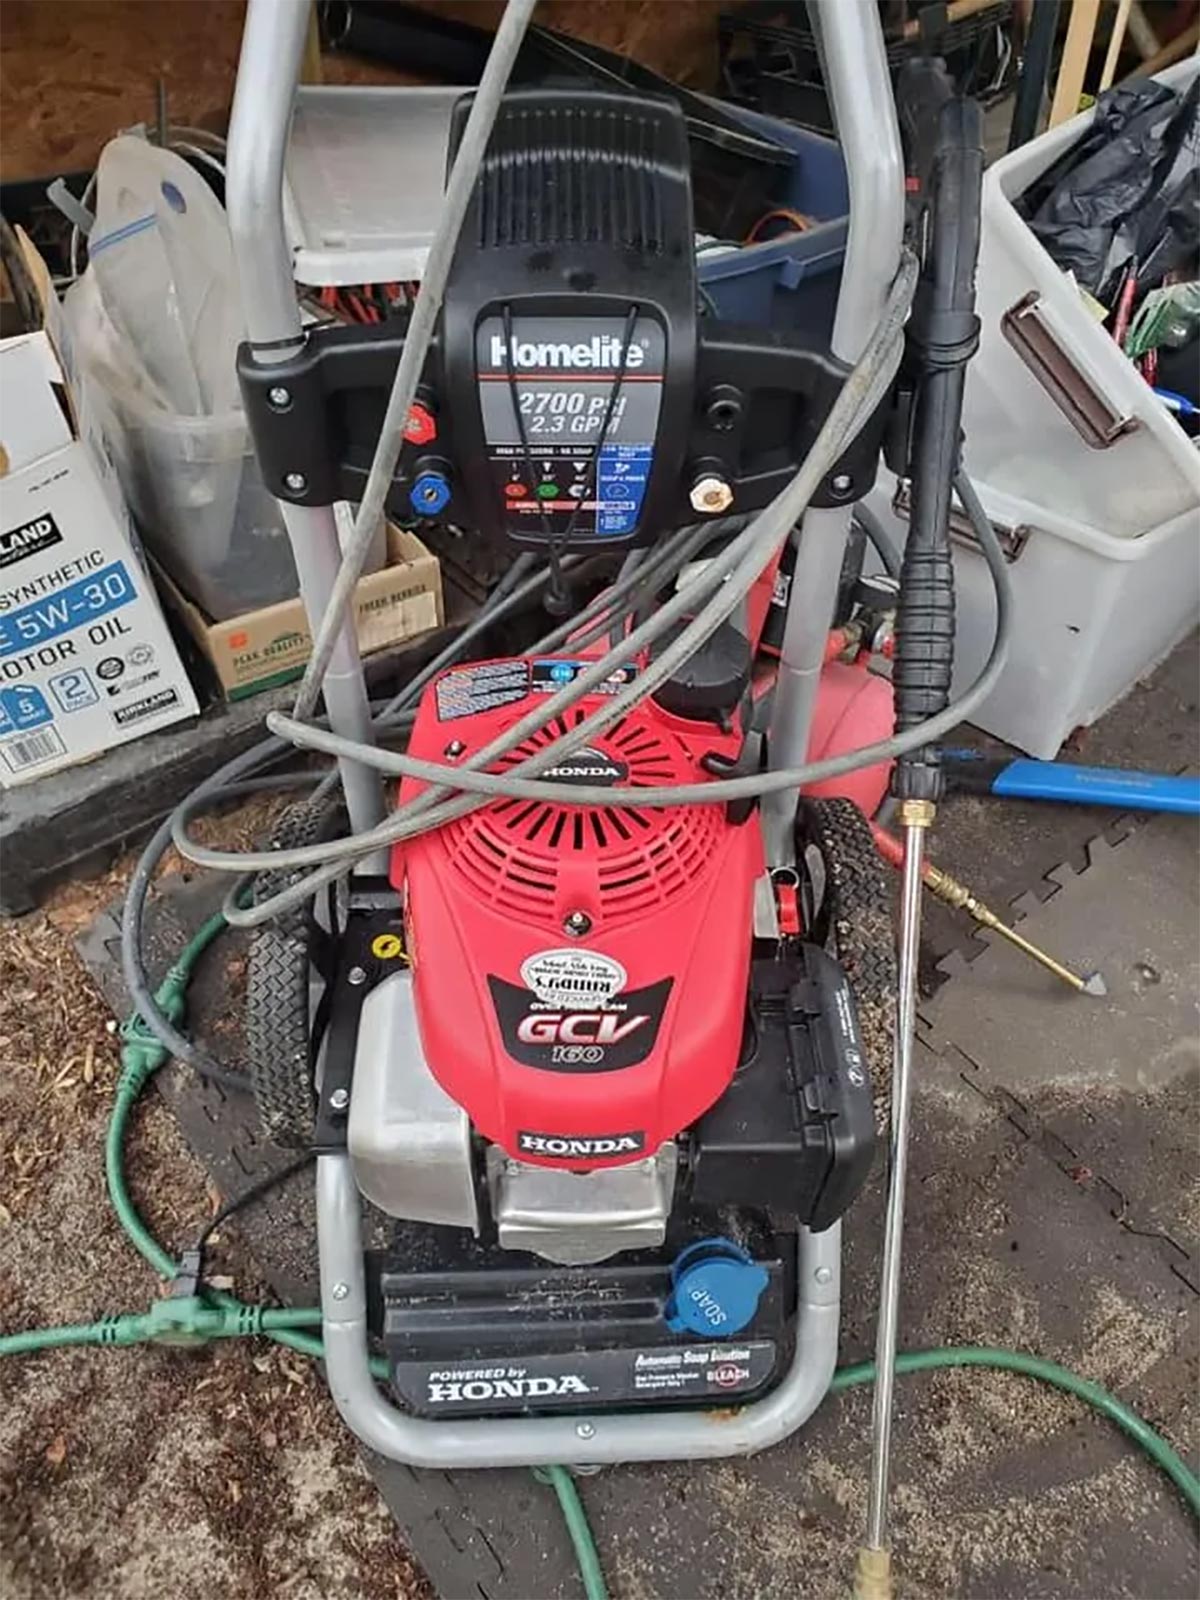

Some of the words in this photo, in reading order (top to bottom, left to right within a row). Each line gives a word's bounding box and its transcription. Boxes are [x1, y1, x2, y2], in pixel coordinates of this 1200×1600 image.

[490, 335, 645, 368] Homelite
[519, 392, 585, 415] 2700
[530, 415, 565, 433] 2.3
[0, 550, 105, 610] SYNTHETIC
[16, 572, 127, 640] 5W-30
[0, 639, 77, 683] OTOR
[88, 617, 132, 646] OIL
[59, 675, 87, 699] 2
[19, 698, 35, 715] 5
[517, 1014, 651, 1044] GCV
[551, 1045, 605, 1063] 160
[520, 1135, 640, 1154] HONDA
[691, 1290, 727, 1325] SOAP
[429, 1368, 506, 1382] POWERED
[507, 1367, 527, 1379] by
[706, 1369, 750, 1382] BLEACH
[427, 1375, 590, 1402] HONDA
